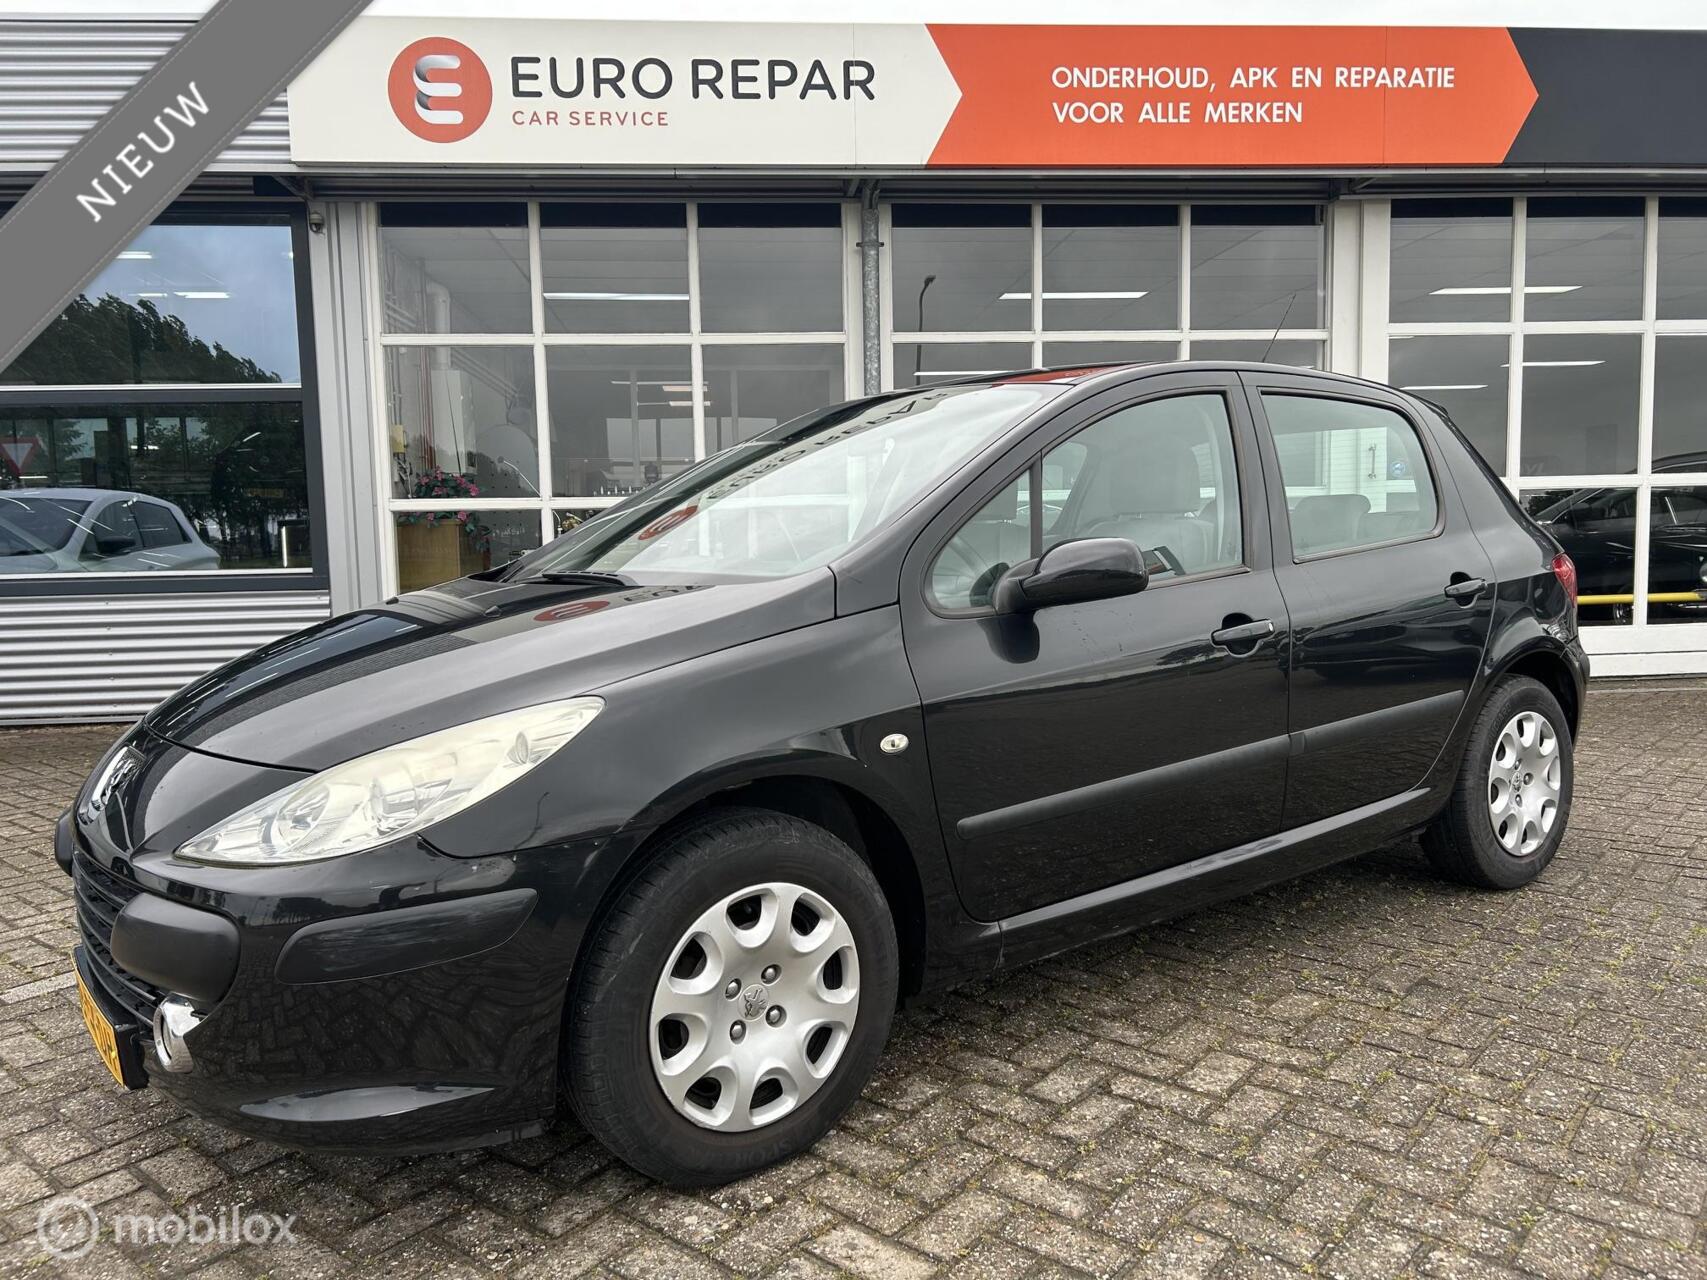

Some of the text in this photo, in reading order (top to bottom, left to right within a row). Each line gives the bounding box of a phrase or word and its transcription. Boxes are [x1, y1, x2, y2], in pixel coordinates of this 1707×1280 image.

[510, 56, 875, 101] EURO REPAR
[1051, 66, 1455, 92] ONDERHOUD, APK EN REPARATIE
[511, 110, 669, 127] CAR SERVICE
[1052, 102, 1303, 124] VOOR ALLE MERKEN
